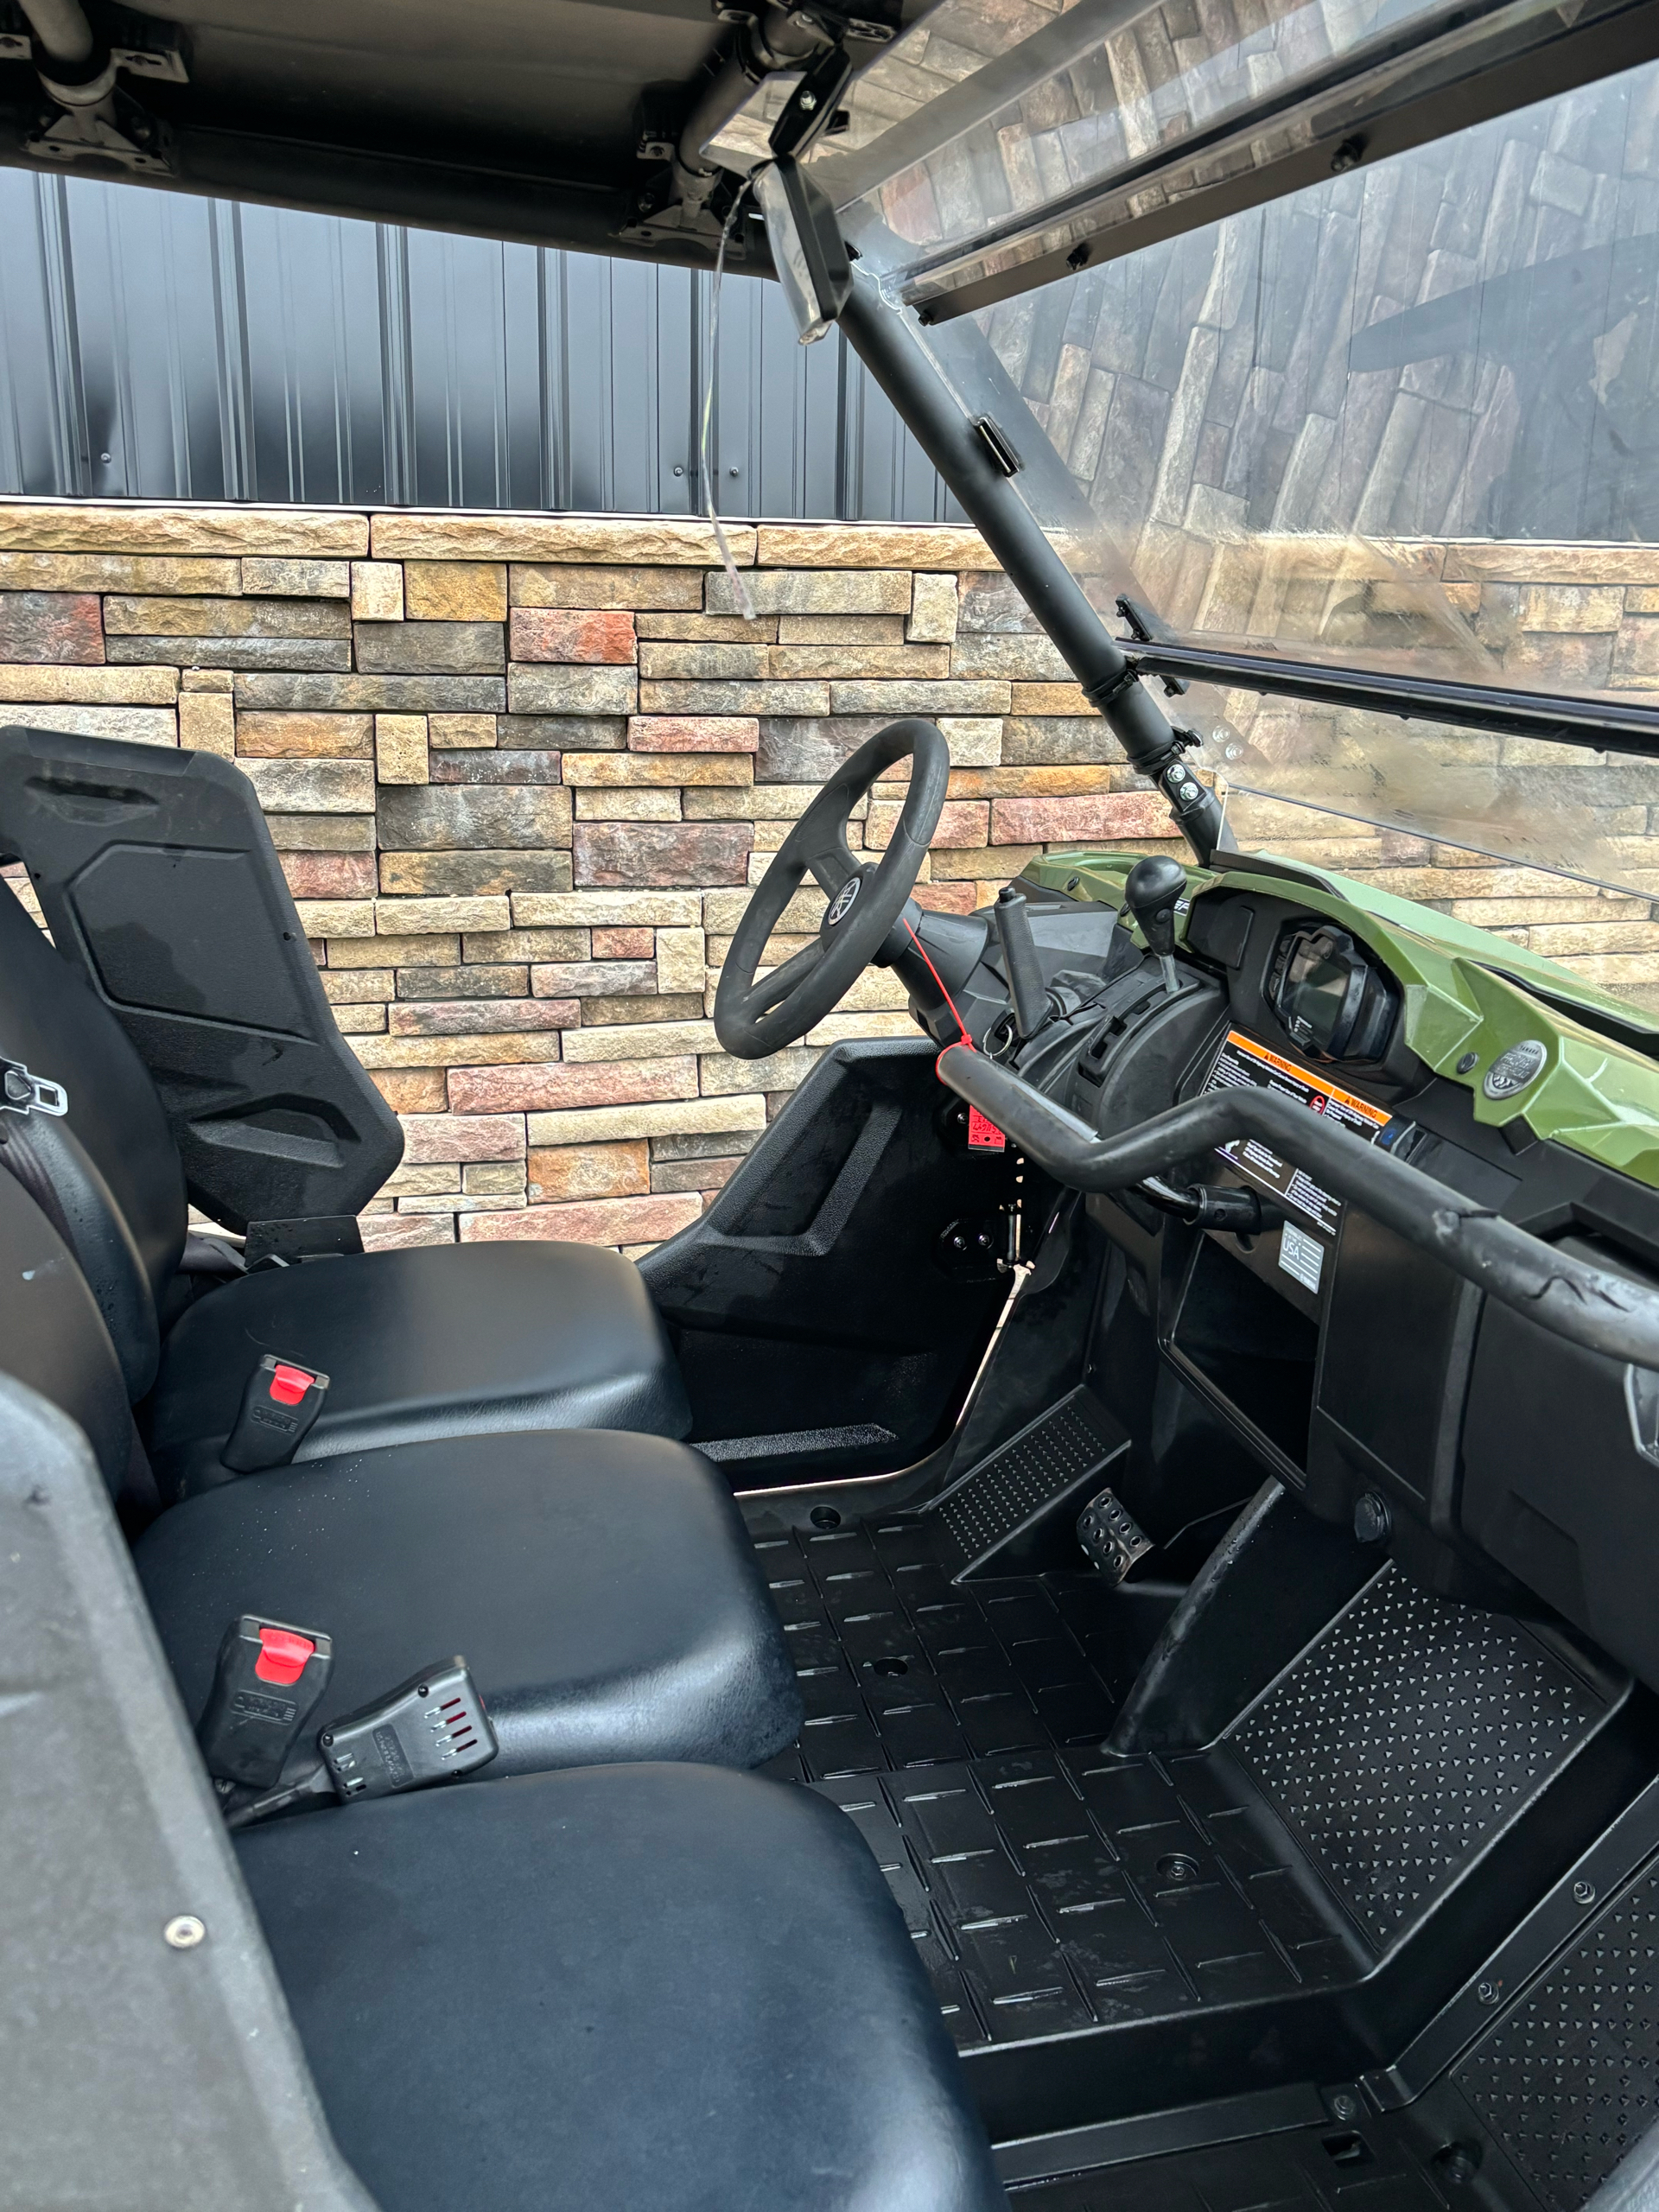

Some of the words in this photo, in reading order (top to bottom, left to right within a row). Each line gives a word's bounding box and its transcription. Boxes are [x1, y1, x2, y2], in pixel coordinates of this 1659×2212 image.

[1270, 1056, 1292, 1072] WARNING
[1351, 1097, 1378, 1118] WARNING
[1282, 1236, 1300, 1261] USA
